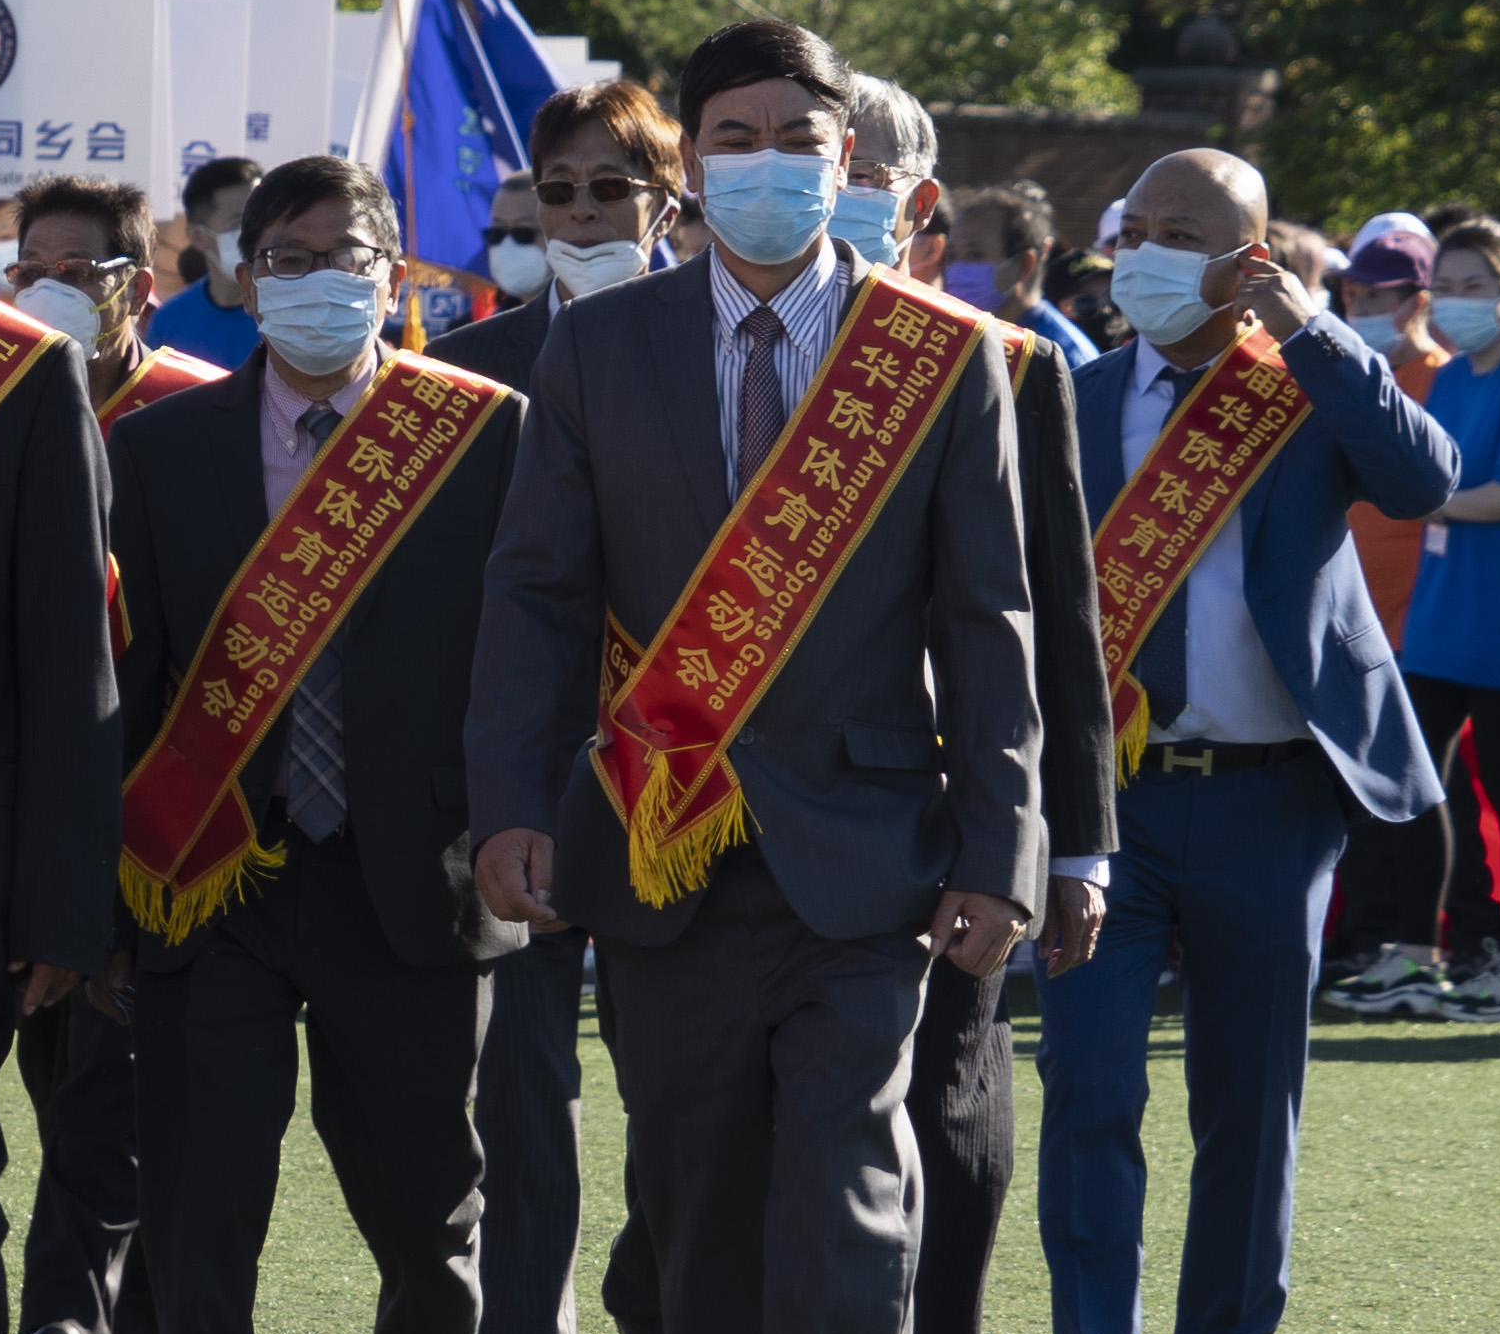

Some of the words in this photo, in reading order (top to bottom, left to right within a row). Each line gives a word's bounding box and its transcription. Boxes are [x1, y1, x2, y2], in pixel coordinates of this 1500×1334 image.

[924, 320, 960, 356] 1st
[445, 388, 479, 420] 1st
[871, 356, 940, 446] Chinese
[391, 417, 458, 491] Chinese
[1219, 406, 1287, 477] Chinese
[806, 444, 887, 558] American
[1153, 475, 1230, 570] American
[320, 488, 403, 590] American
[262, 591, 332, 666] Sports
[748, 560, 818, 640] Sports
[1114, 571, 1164, 640] Sports
[227, 668, 279, 733] Game
[708, 643, 765, 710] Game
